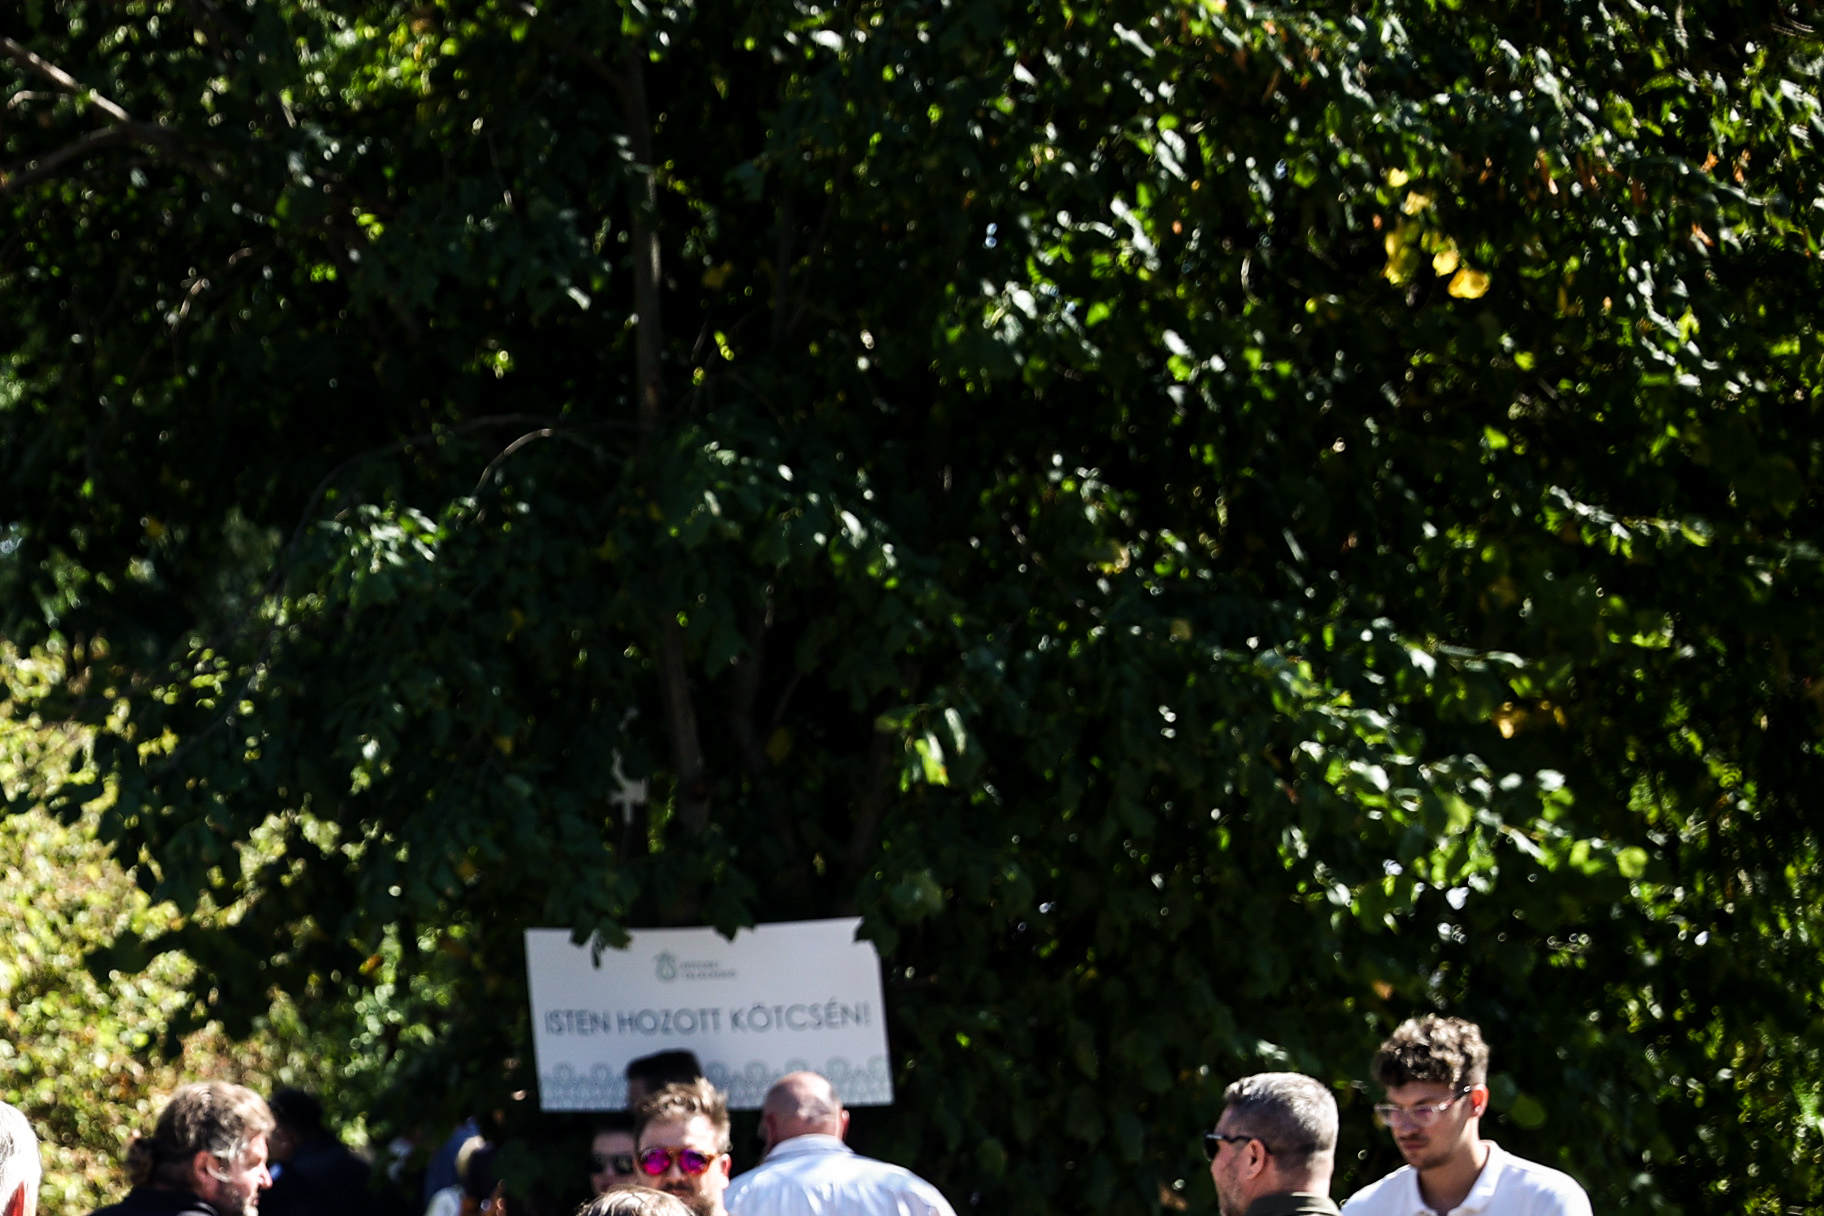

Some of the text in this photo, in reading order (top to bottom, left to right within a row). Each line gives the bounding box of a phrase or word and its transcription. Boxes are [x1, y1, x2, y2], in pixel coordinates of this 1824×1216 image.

[546, 996, 871, 1035] ISTEN HOZOTT KÖTCSÉN!
